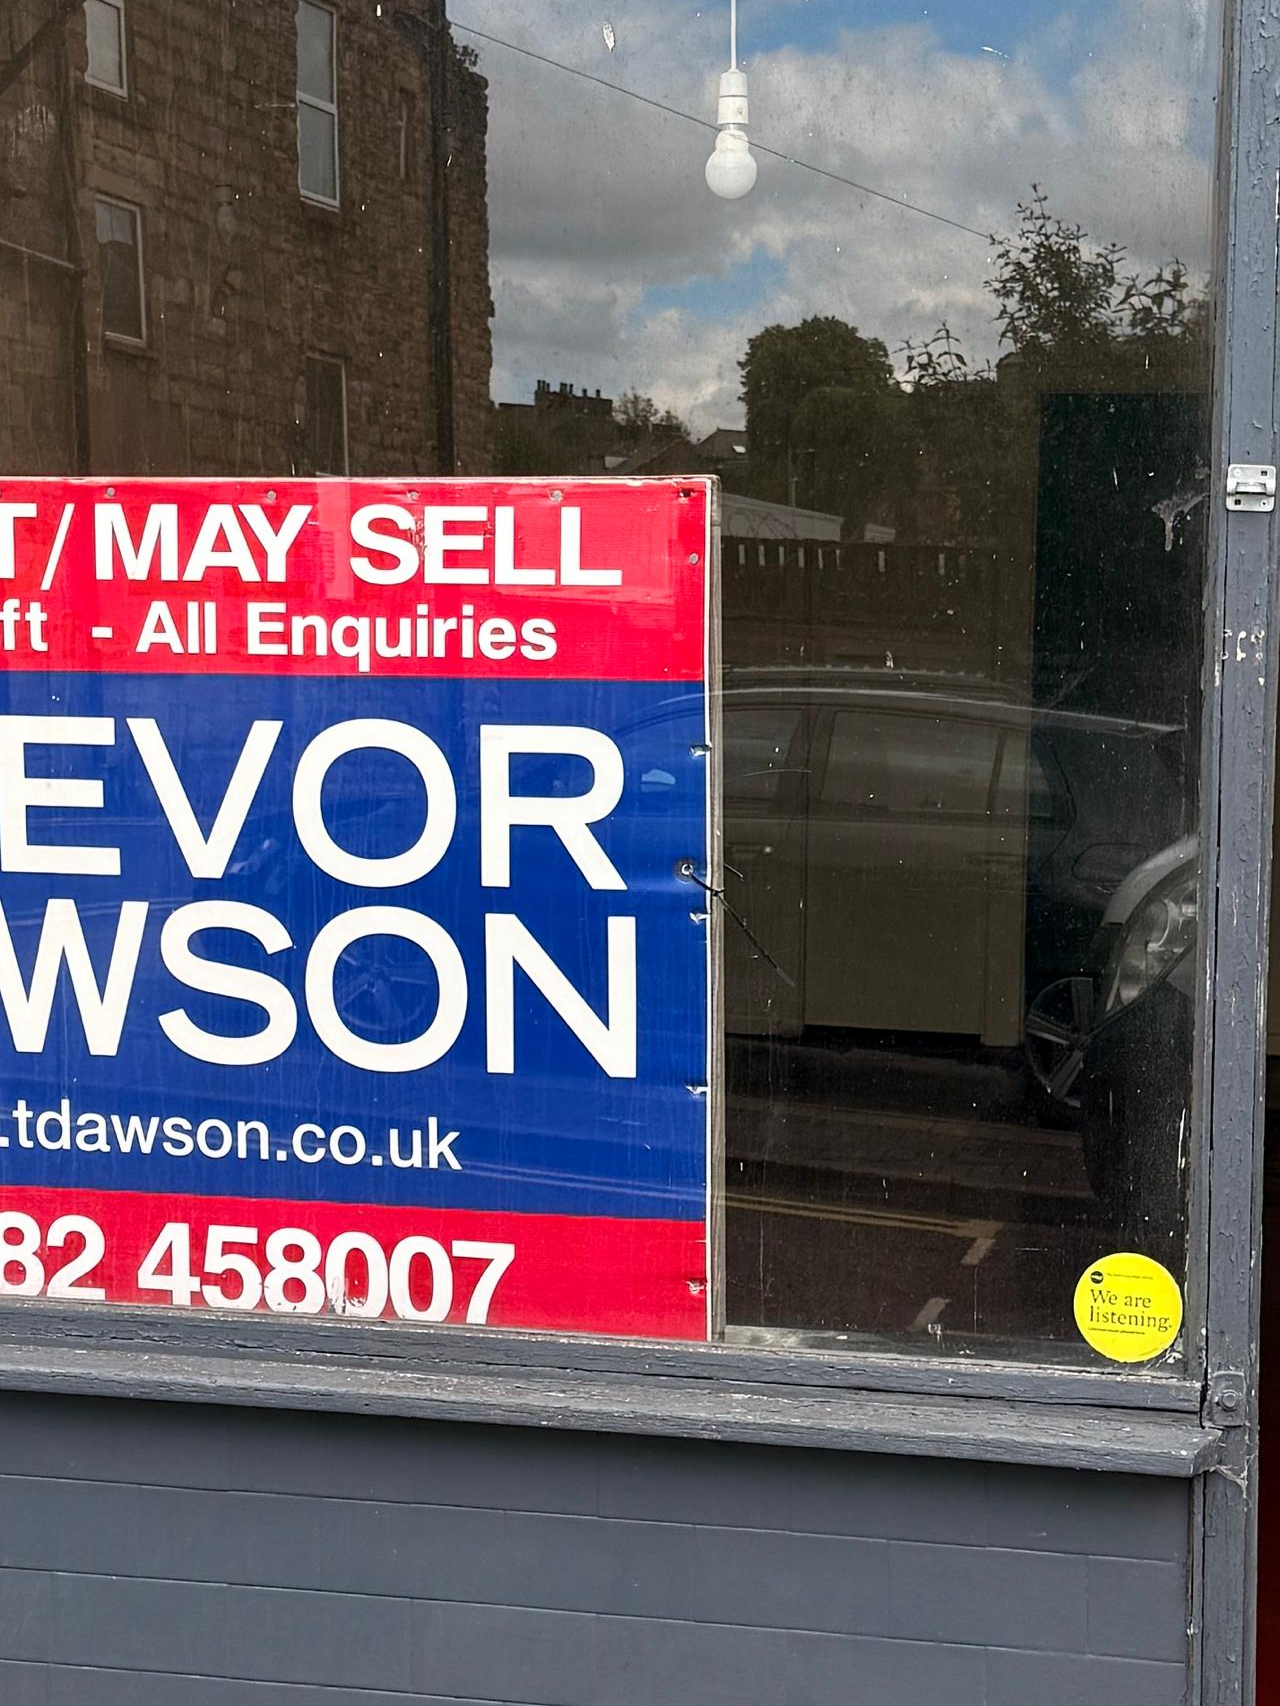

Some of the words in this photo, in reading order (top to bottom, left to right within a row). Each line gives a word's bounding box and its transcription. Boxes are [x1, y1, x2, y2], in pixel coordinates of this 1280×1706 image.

[349, 504, 623, 586] SELL
[135, 600, 217, 654] All
[247, 601, 558, 673] Enquiries
[137, 1222, 516, 1325] 458007
[1090, 1289, 1118, 1306] We
[1124, 1295, 1152, 1309] are
[1089, 1305, 1173, 1333] listening.
